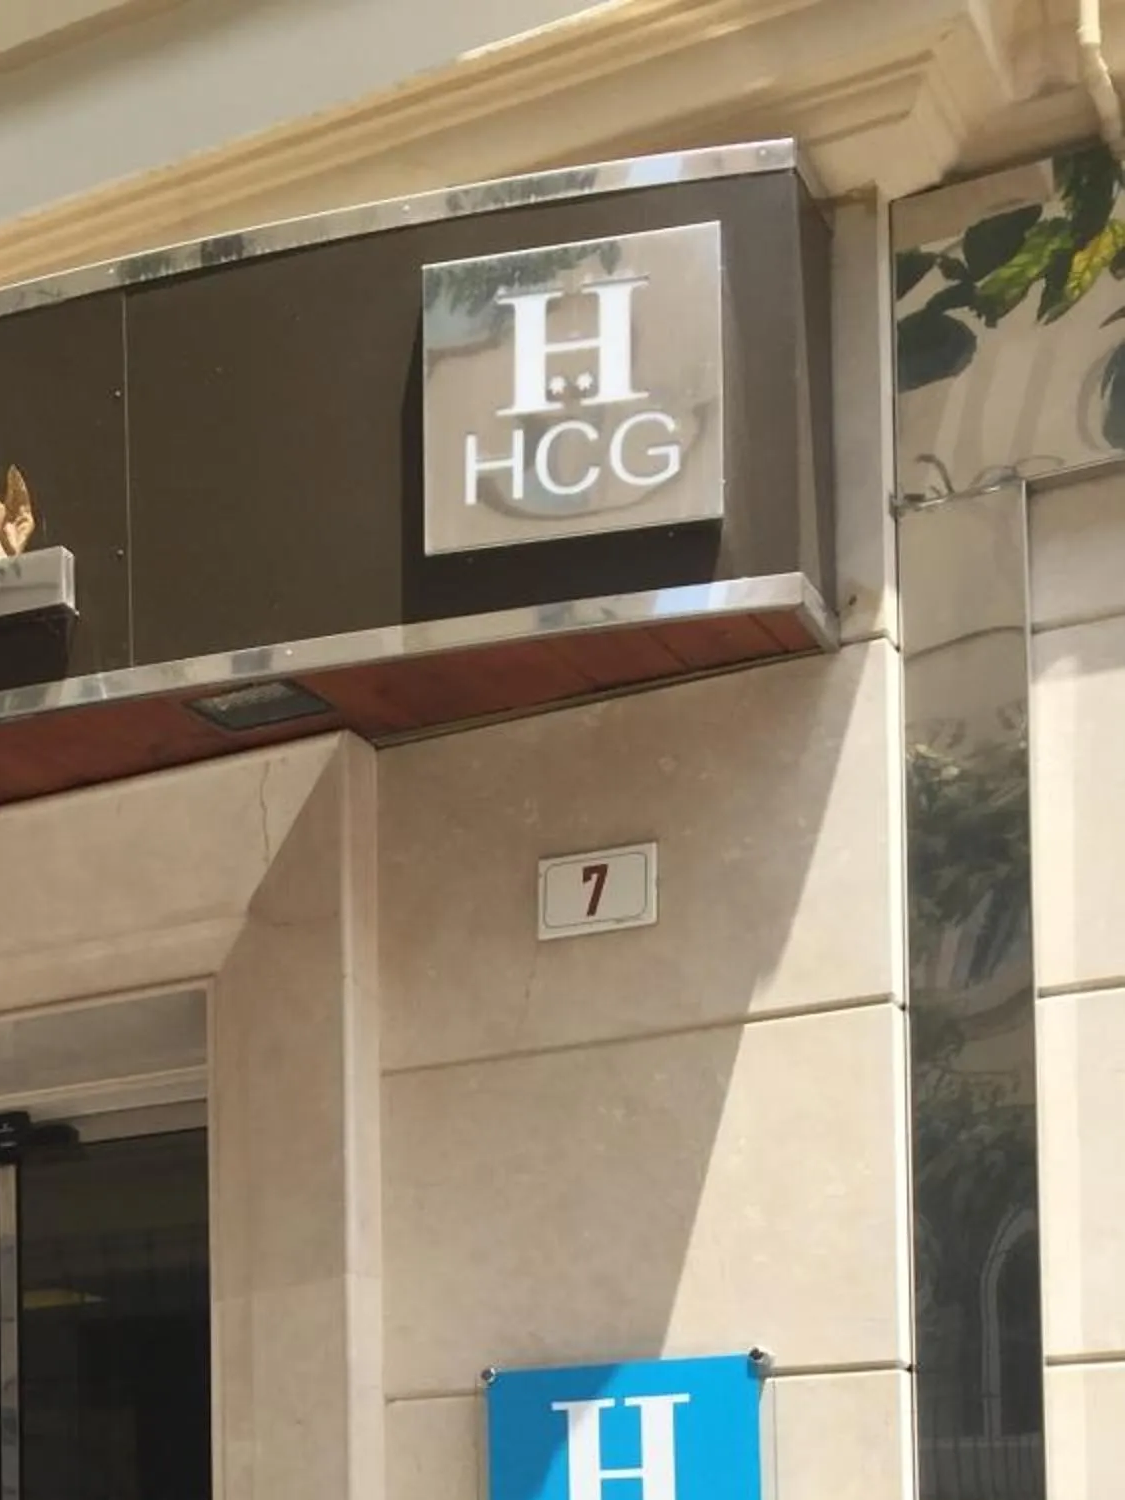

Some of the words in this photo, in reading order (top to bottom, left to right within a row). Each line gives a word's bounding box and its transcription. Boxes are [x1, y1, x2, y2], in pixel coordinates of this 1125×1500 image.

[495, 273, 650, 417] H
[464, 411, 681, 506] HCG
[581, 863, 609, 917] 7
